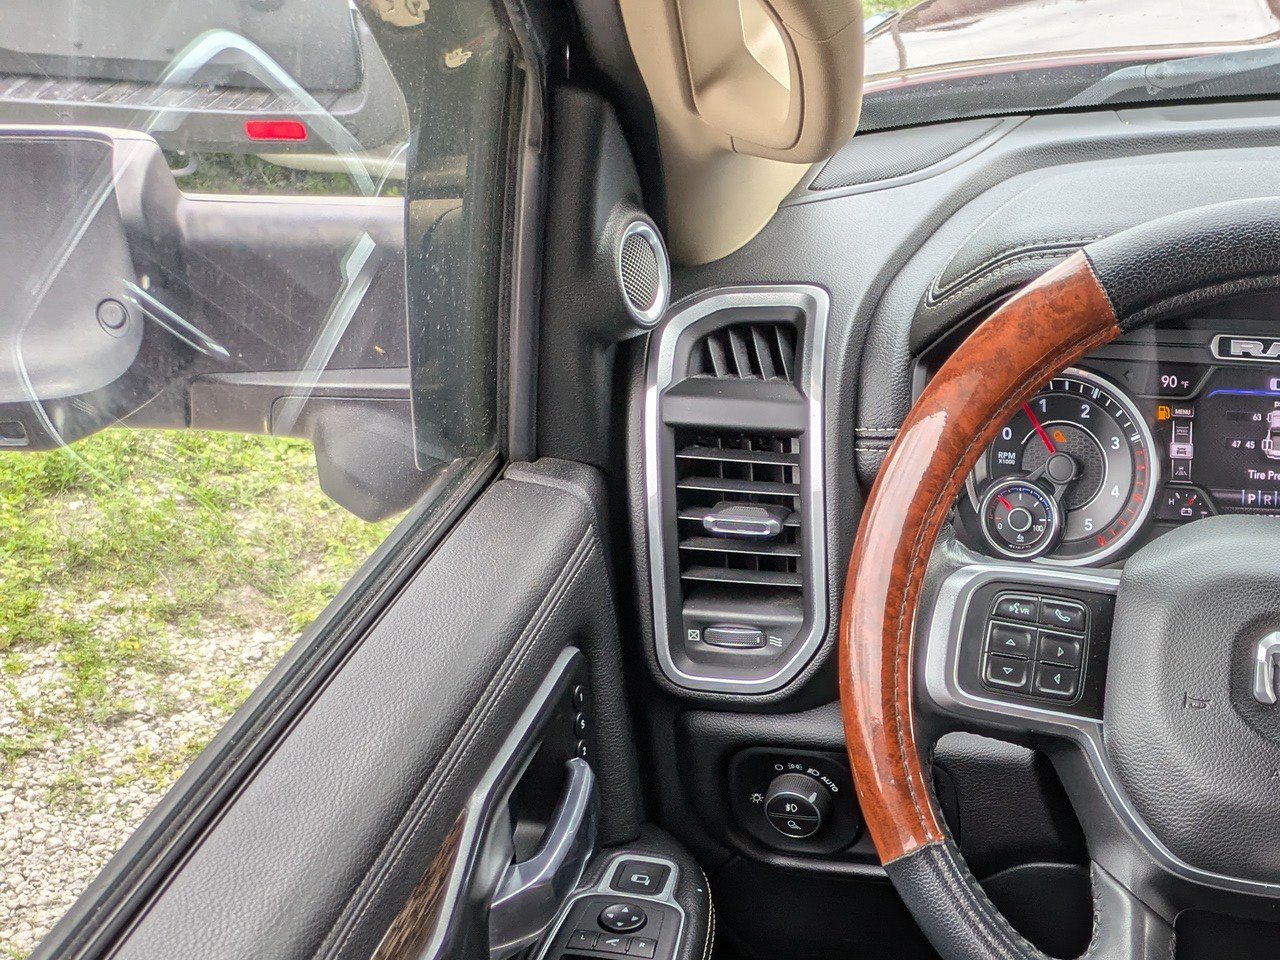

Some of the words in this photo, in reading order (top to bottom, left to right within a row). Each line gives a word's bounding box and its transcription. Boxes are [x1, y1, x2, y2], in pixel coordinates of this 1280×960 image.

[1160, 375, 1178, 388] 90
[1038, 399, 1047, 413] 1
[1080, 404, 1090, 419] 2
[1002, 427, 1012, 440] 0
[1110, 436, 1120, 450] 3
[998, 451, 1016, 460] RPM
[1248, 469, 1266, 480] Tire
[1110, 485, 1120, 498] 4
[1084, 518, 1093, 531] 5
[821, 775, 839, 793] AUTO
